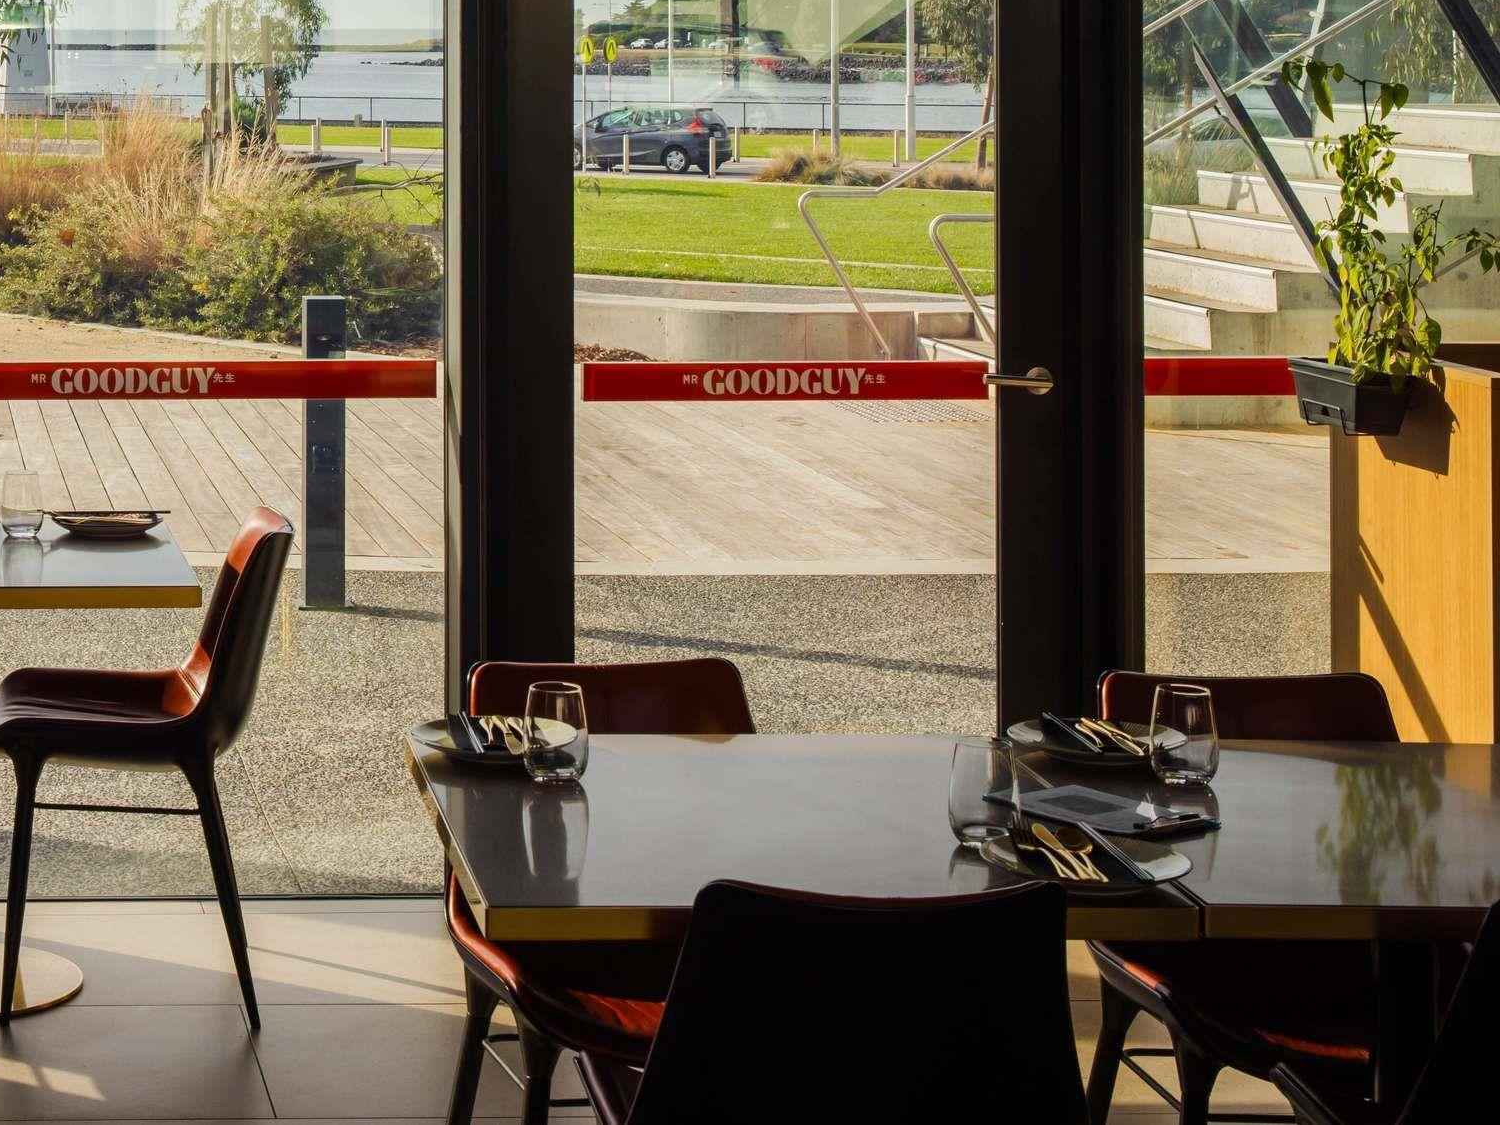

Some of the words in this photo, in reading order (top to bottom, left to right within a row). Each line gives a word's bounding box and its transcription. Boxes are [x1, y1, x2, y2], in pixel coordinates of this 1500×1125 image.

[30, 373, 46, 383] MR
[51, 367, 215, 394] GOODGUY
[213, 373, 235, 383] 先生
[683, 374, 698, 385] MR
[702, 368, 866, 395] GOODGUY
[864, 374, 886, 384] 先生
